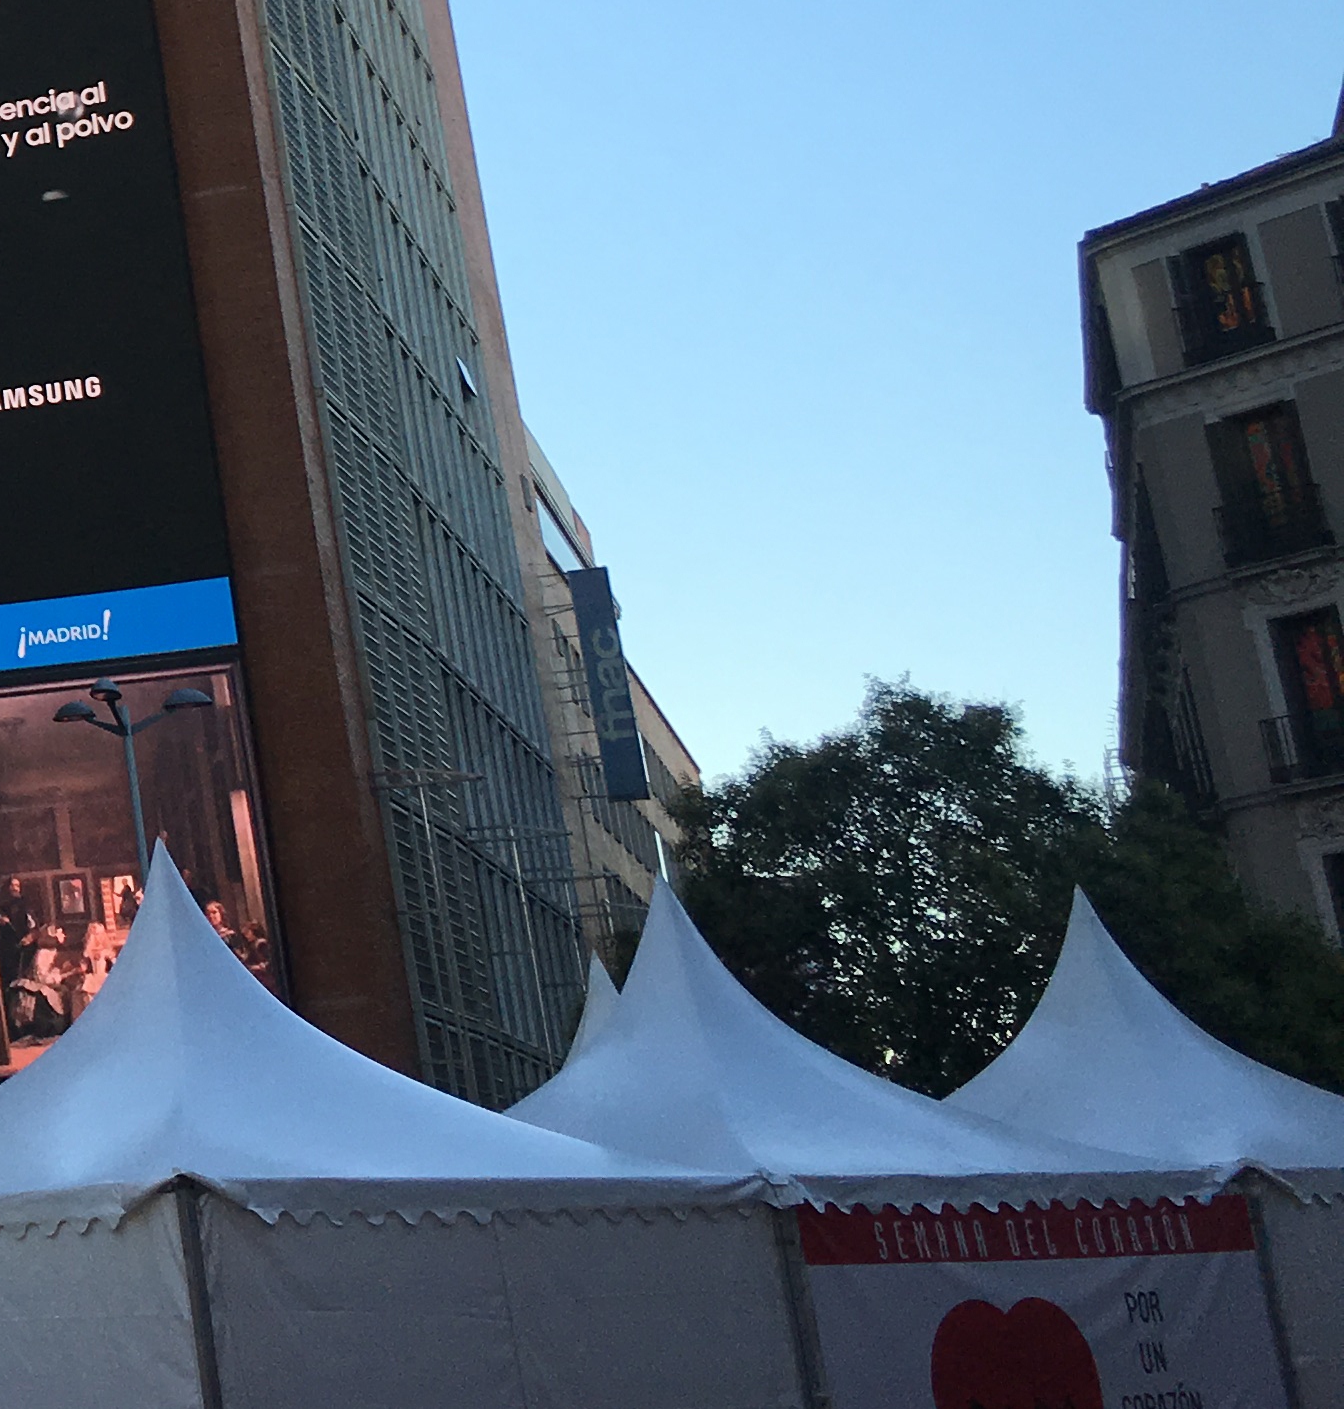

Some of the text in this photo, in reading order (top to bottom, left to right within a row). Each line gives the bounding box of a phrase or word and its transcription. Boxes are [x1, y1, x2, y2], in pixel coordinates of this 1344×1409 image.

[80, 80, 107, 106] al
[0, 131, 20, 158] y
[25, 122, 51, 147] al
[55, 111, 134, 148] polvo
[17, 608, 112, 659] ¡MADRID!
[591, 626, 636, 741] fnac
[874, 1219, 989, 1261] SEMANA
[1005, 1217, 1058, 1257] DEL
[1123, 1290, 1164, 1324] POR
[1137, 1341, 1168, 1374] UN
